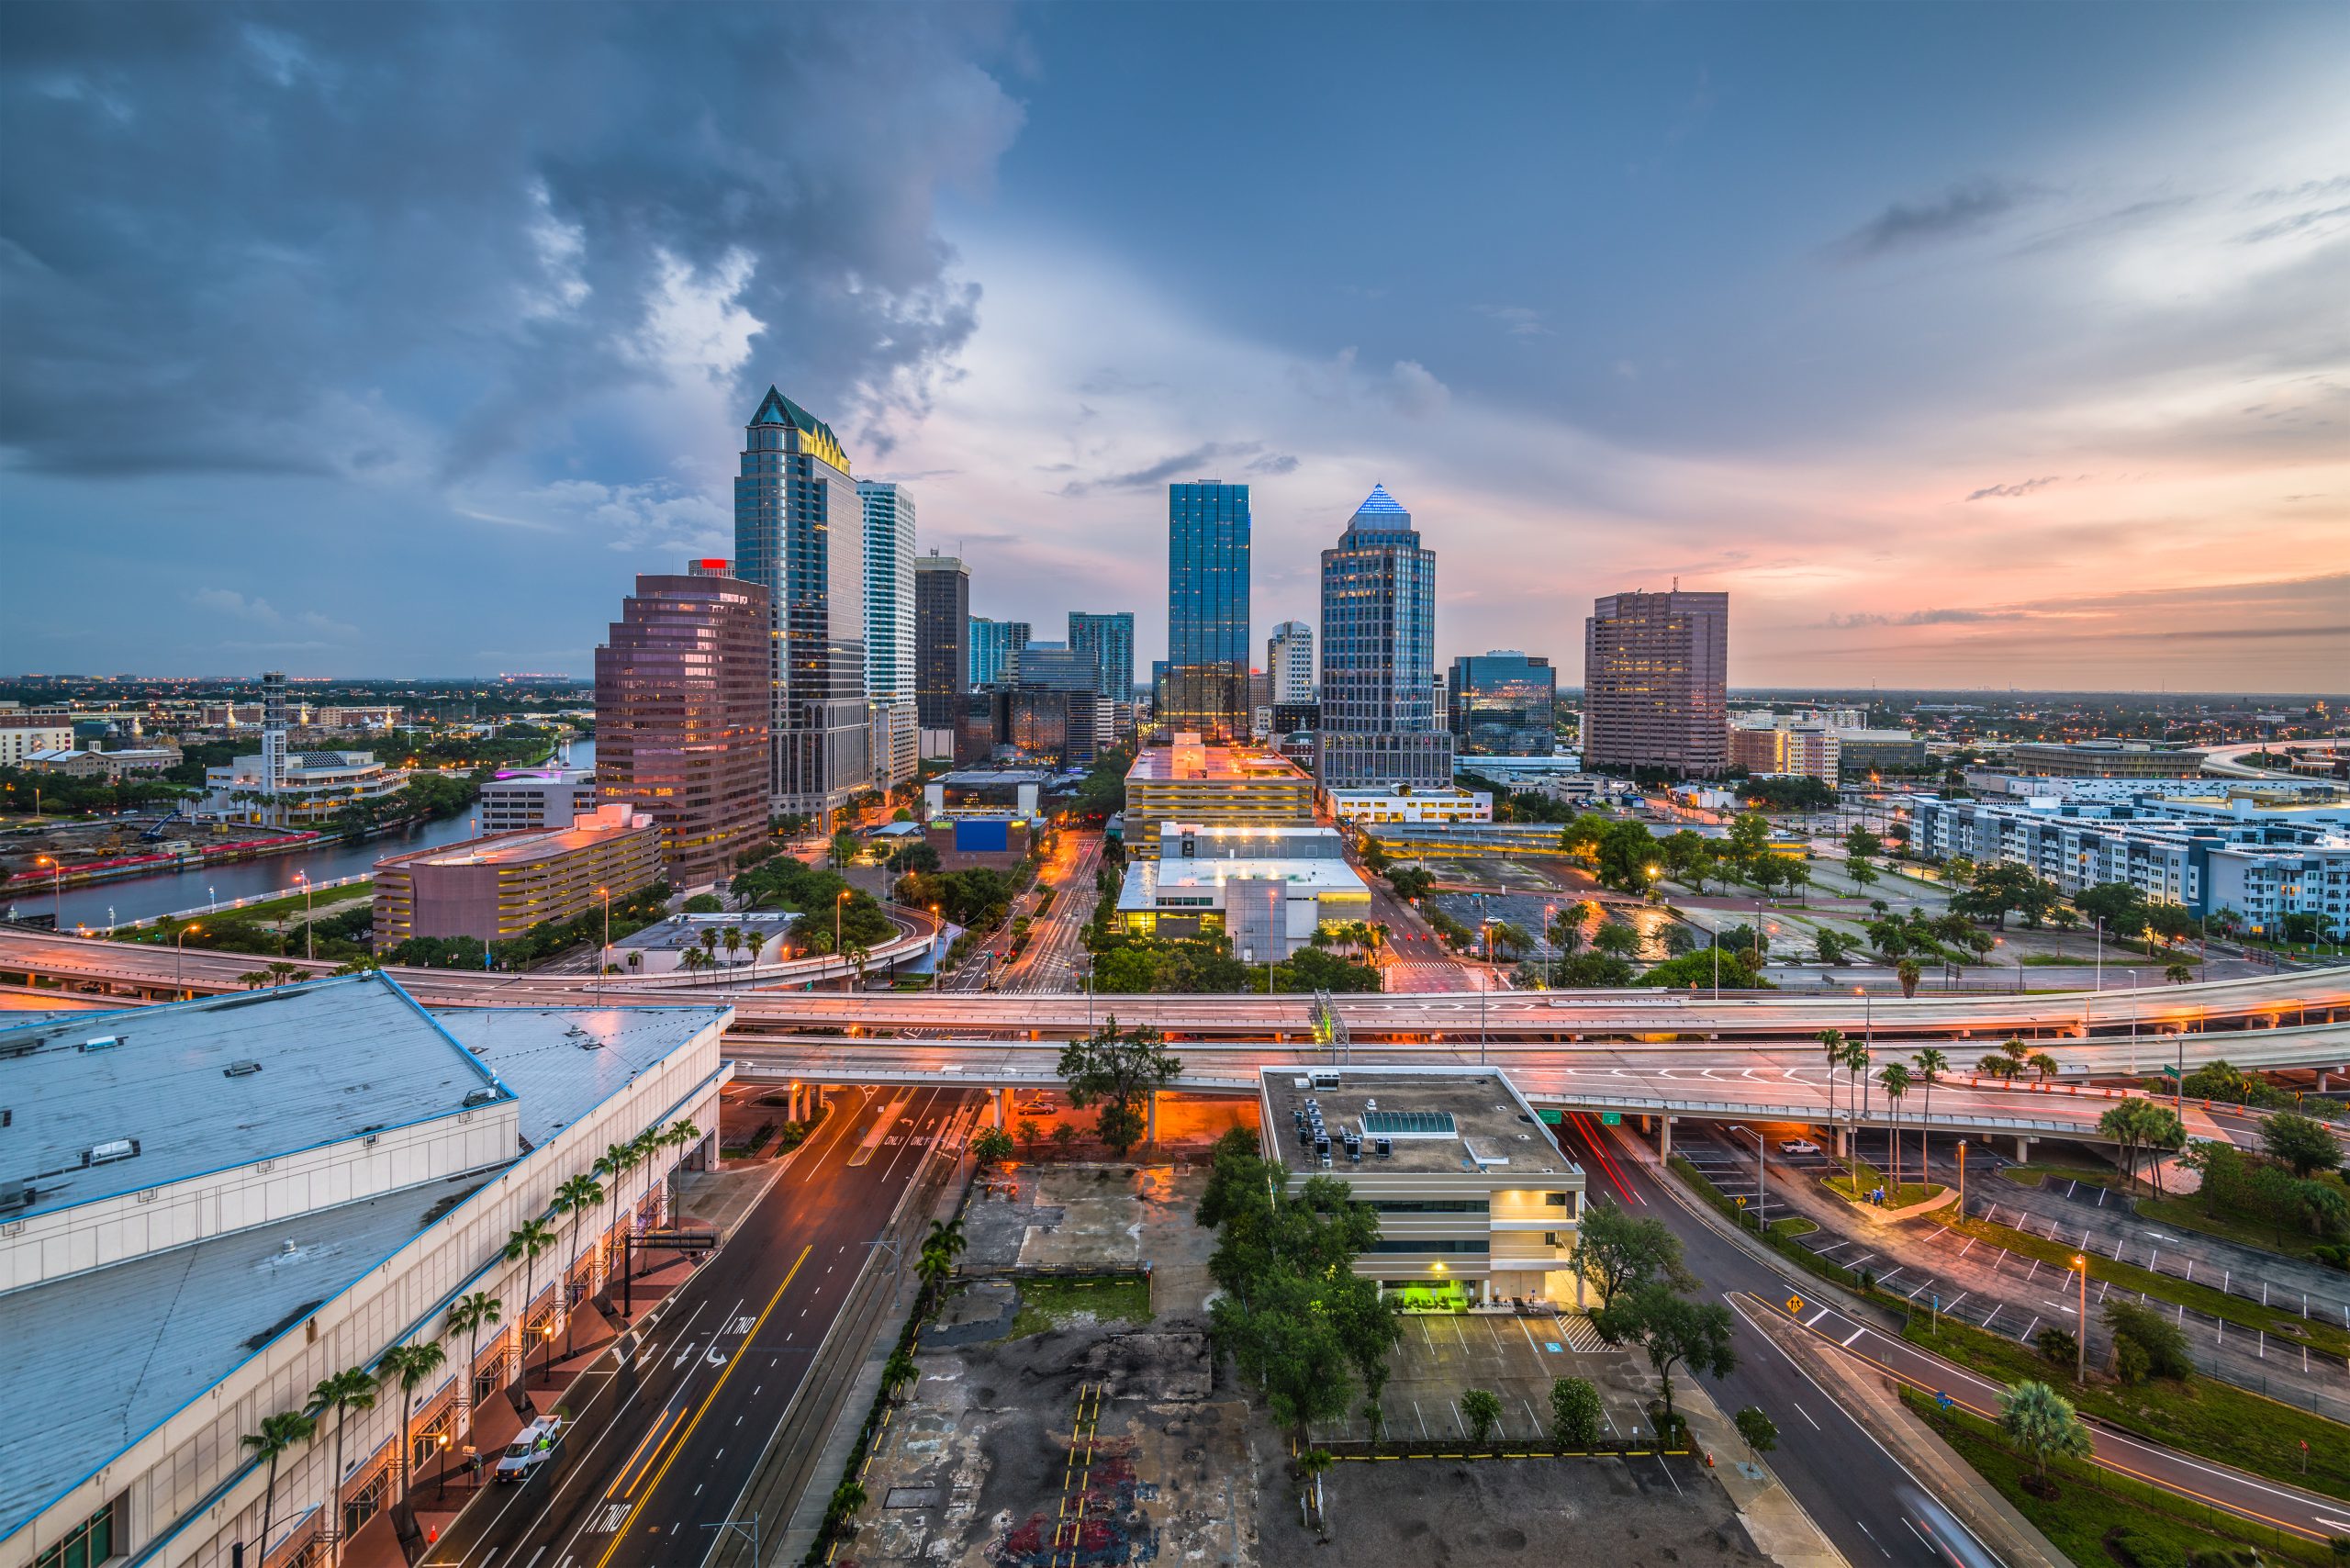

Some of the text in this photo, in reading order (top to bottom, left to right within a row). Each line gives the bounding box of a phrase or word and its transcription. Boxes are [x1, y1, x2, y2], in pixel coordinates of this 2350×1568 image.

[884, 1136, 905, 1146] ONLY
[910, 1136, 931, 1146] ONLY
[723, 1316, 756, 1335] ONLY
[586, 1504, 632, 1533] ONLY
